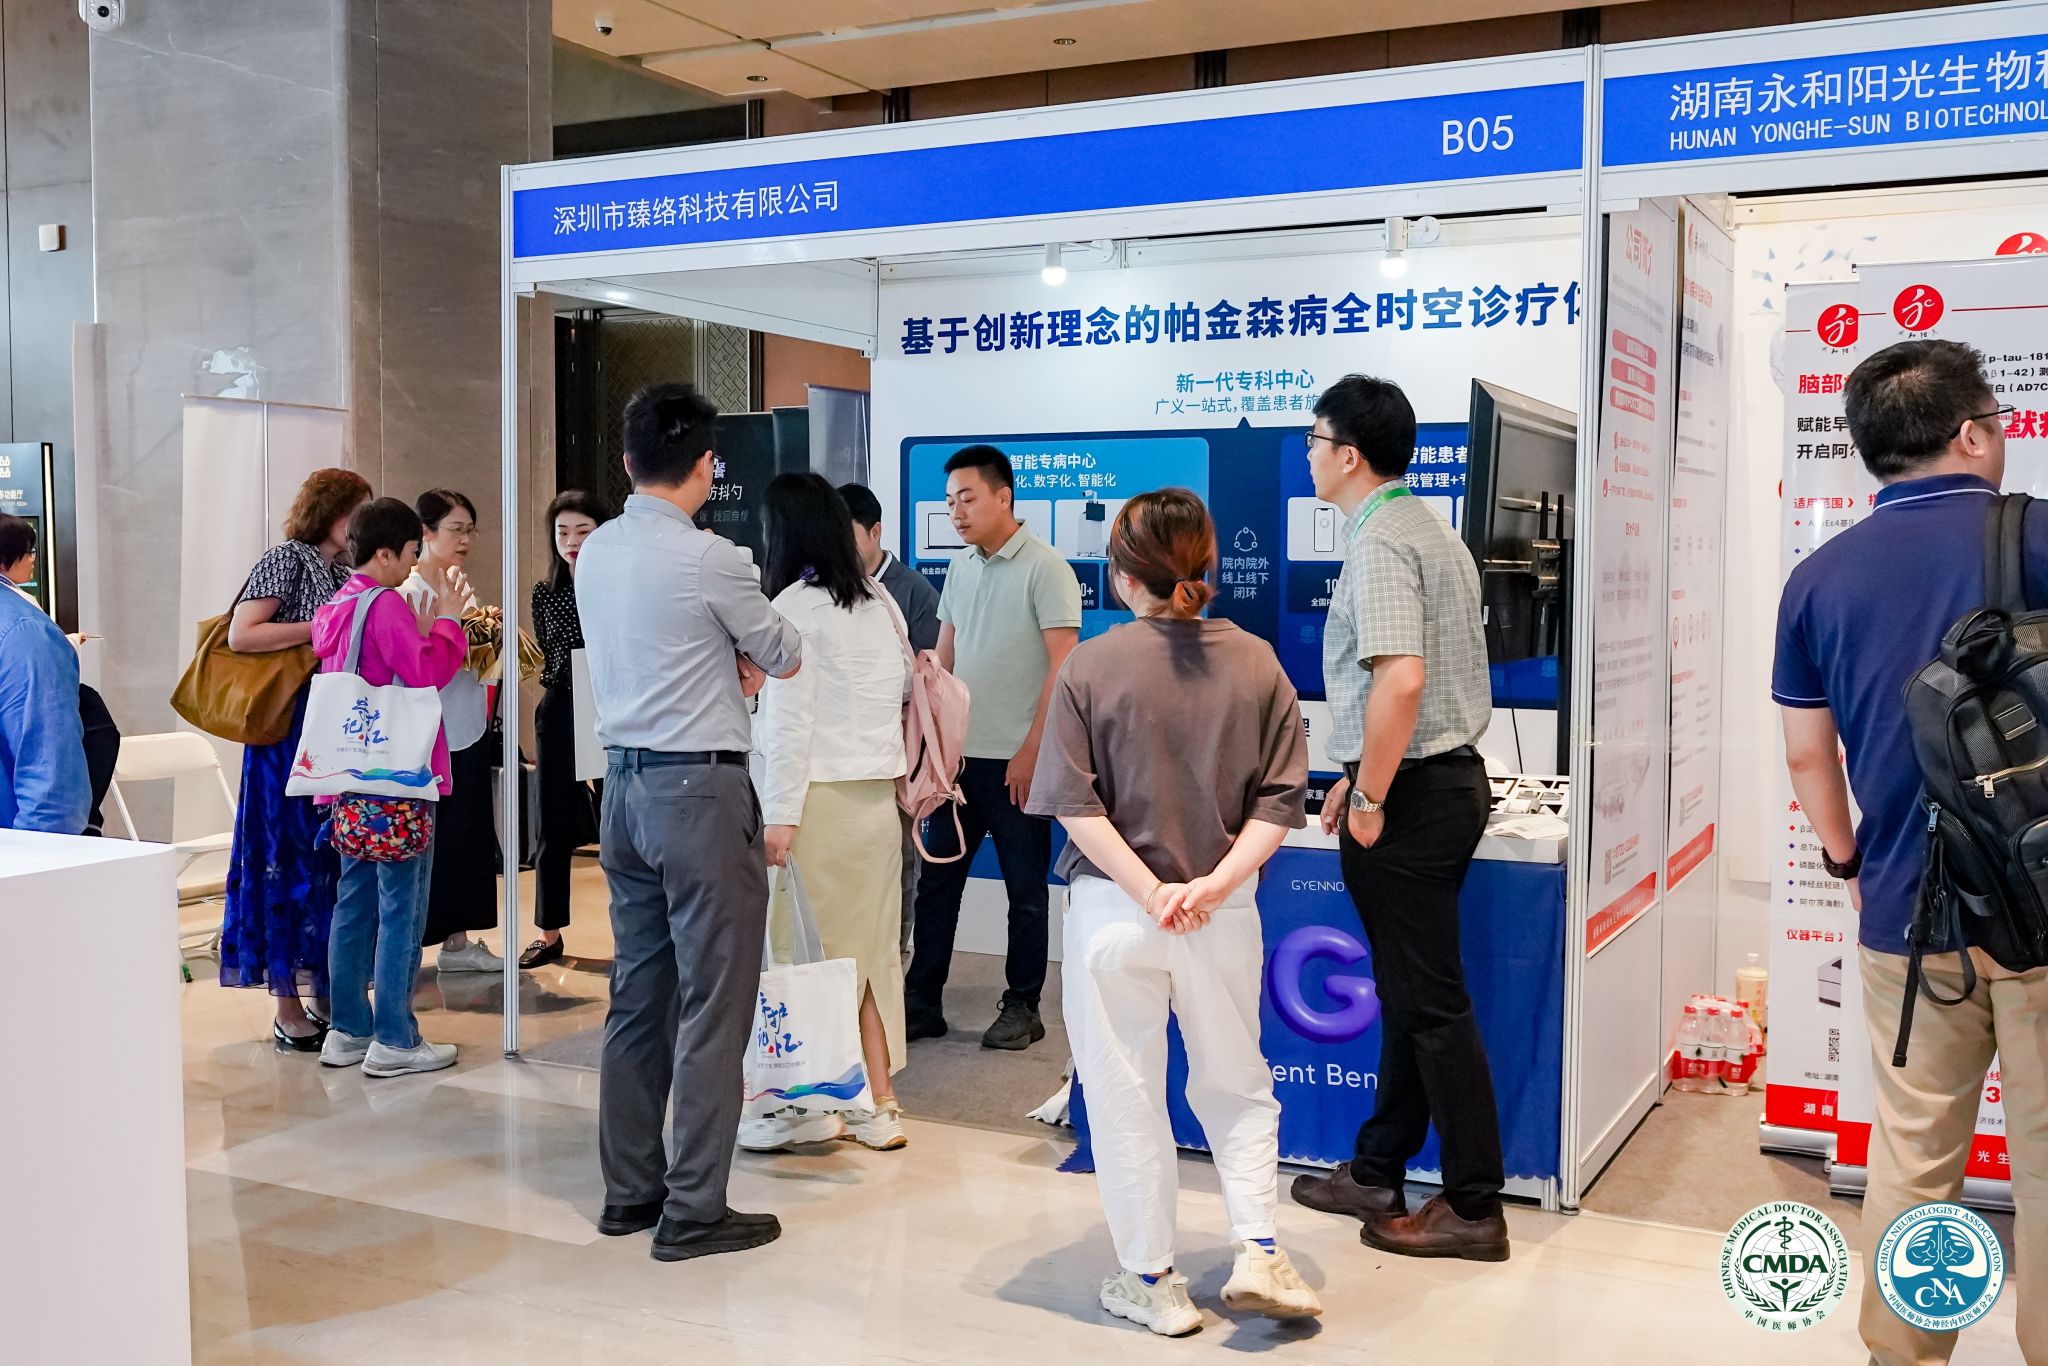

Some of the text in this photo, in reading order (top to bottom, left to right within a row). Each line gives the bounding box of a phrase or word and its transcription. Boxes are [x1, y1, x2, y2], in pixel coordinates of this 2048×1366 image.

[1441, 114, 1515, 156] B05
[1670, 126, 1737, 151] HUNAN
[1750, 113, 1891, 145] YONGHE-SUN
[552, 179, 839, 237] 深圳市臻络科技有限公司
[1176, 369, 1315, 394] 新一代专科中心
[1798, 373, 1850, 395] 脑部
[1010, 452, 1097, 470] 智能专病中心
[1015, 473, 1116, 489] 化、数字化、智能化
[1222, 556, 1269, 570] 院内院外
[1222, 572, 1269, 585] 线上线下
[1233, 586, 1257, 600] 闭环
[1291, 879, 1345, 892] GYENNO
[1786, 928, 1835, 942] 仪器平台
[1266, 1059, 1378, 1090] ent Ben
[1803, 1102, 1834, 1117] 湖南
